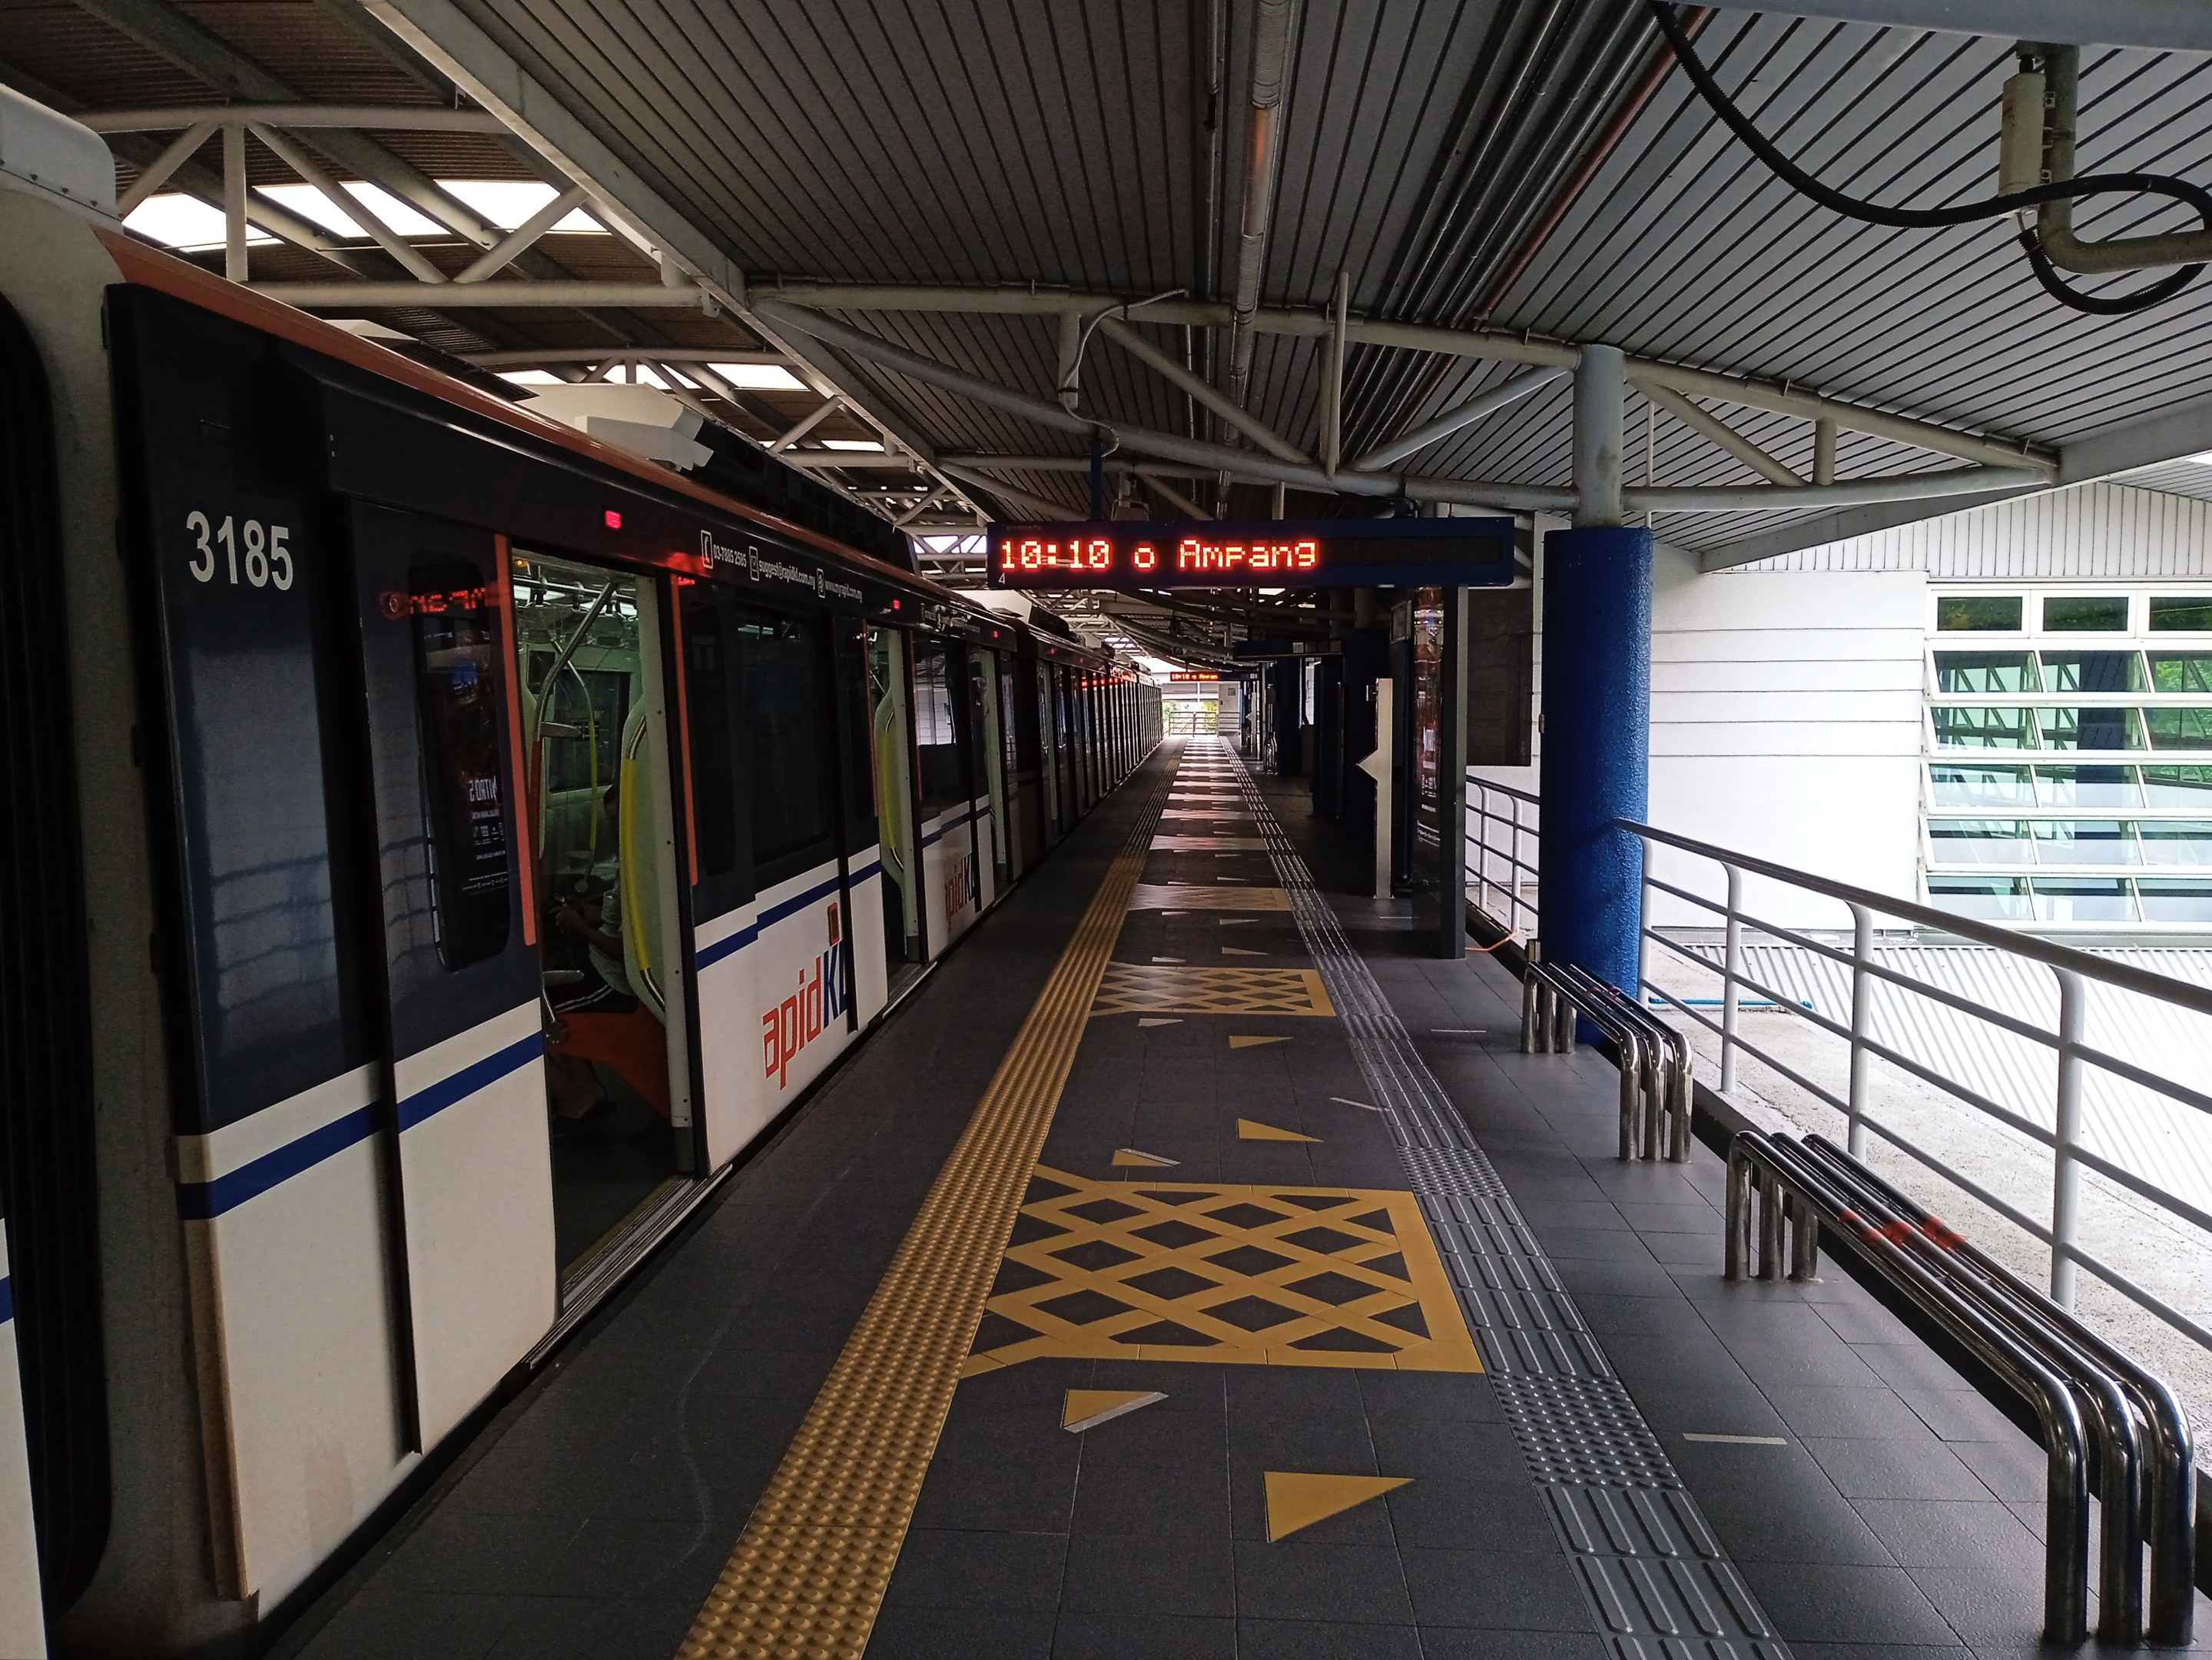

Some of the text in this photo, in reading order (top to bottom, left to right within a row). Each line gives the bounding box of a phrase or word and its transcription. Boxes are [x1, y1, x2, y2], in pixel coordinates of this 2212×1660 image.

[186, 510, 293, 591] 3185
[1001, 540, 1109, 569] 10:10
[1179, 539, 1315, 568] Ampang
[998, 573, 1007, 585] 4
